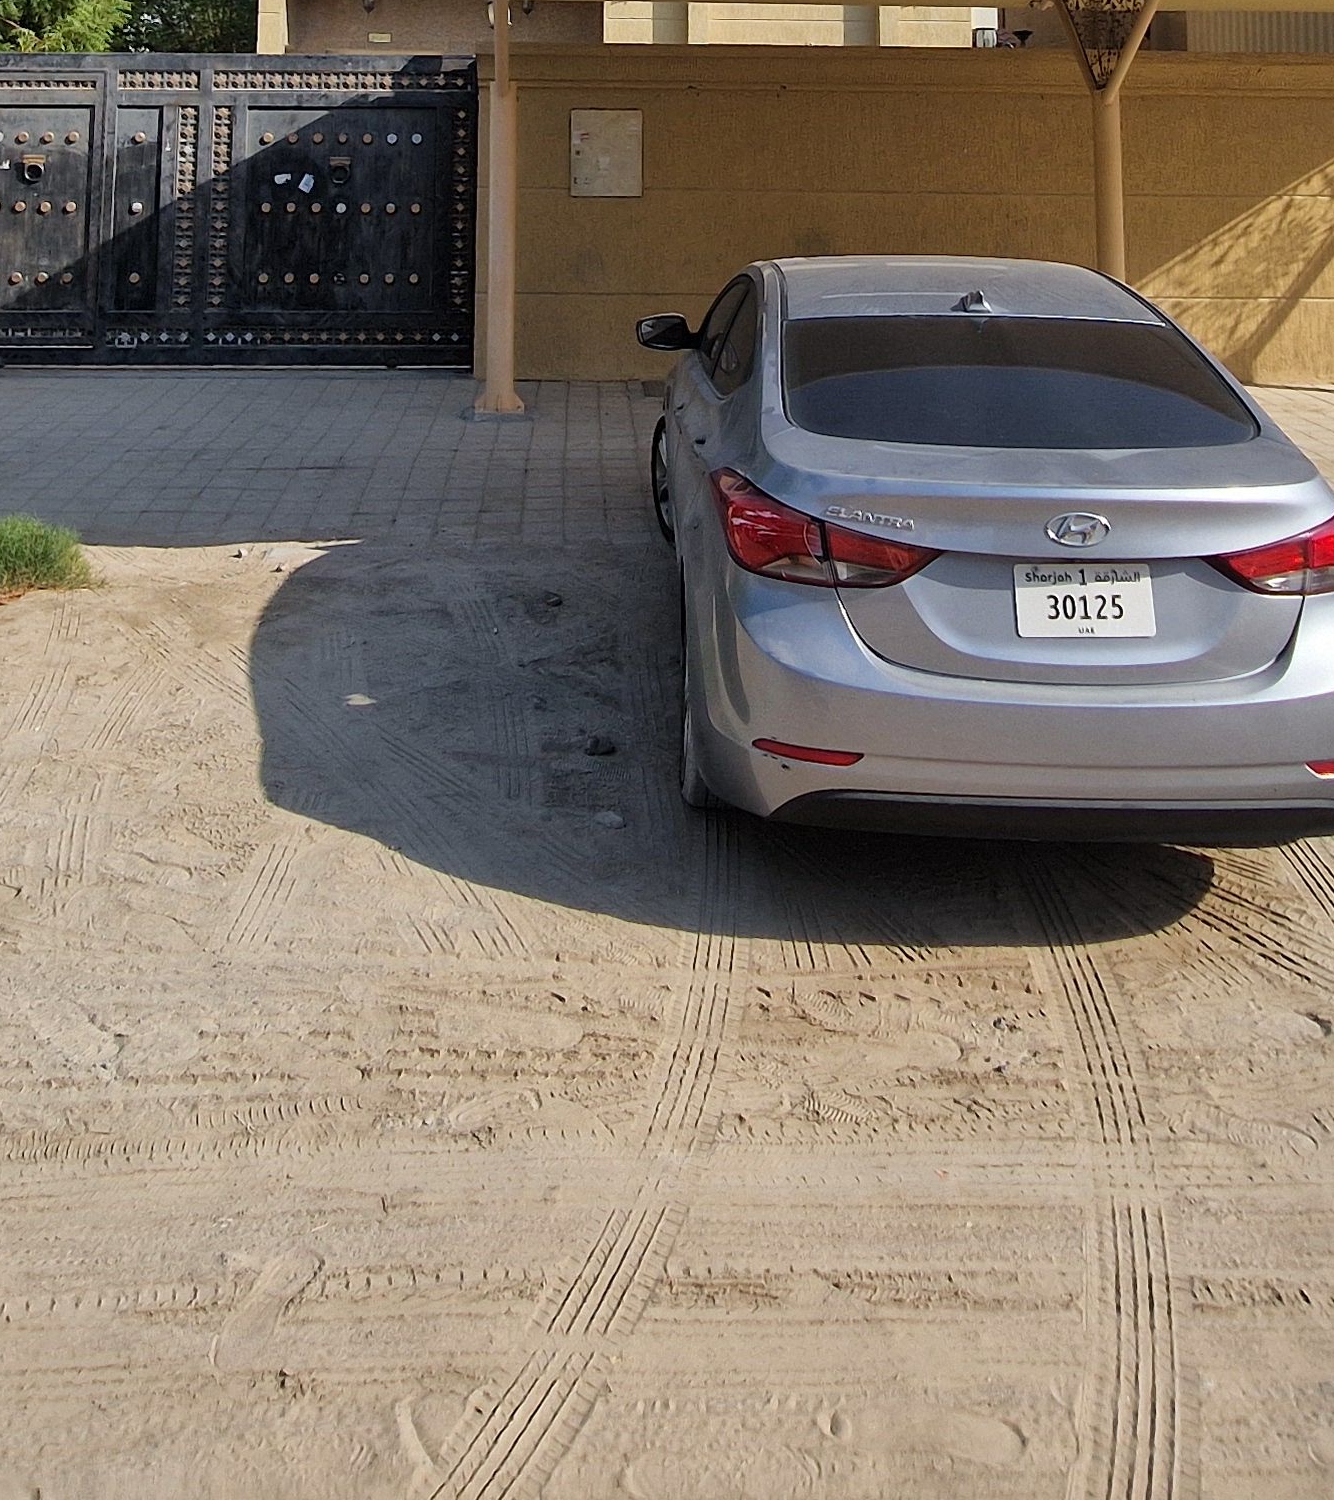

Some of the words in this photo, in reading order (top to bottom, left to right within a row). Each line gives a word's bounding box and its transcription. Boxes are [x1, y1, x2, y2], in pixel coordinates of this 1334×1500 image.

[825, 505, 915, 530] ELANTRA
[1025, 571, 1073, 585] Sharjah
[1078, 569, 1087, 586] 1
[1094, 569, 1141, 585] الشارقة
[1046, 594, 1124, 620] 30125
